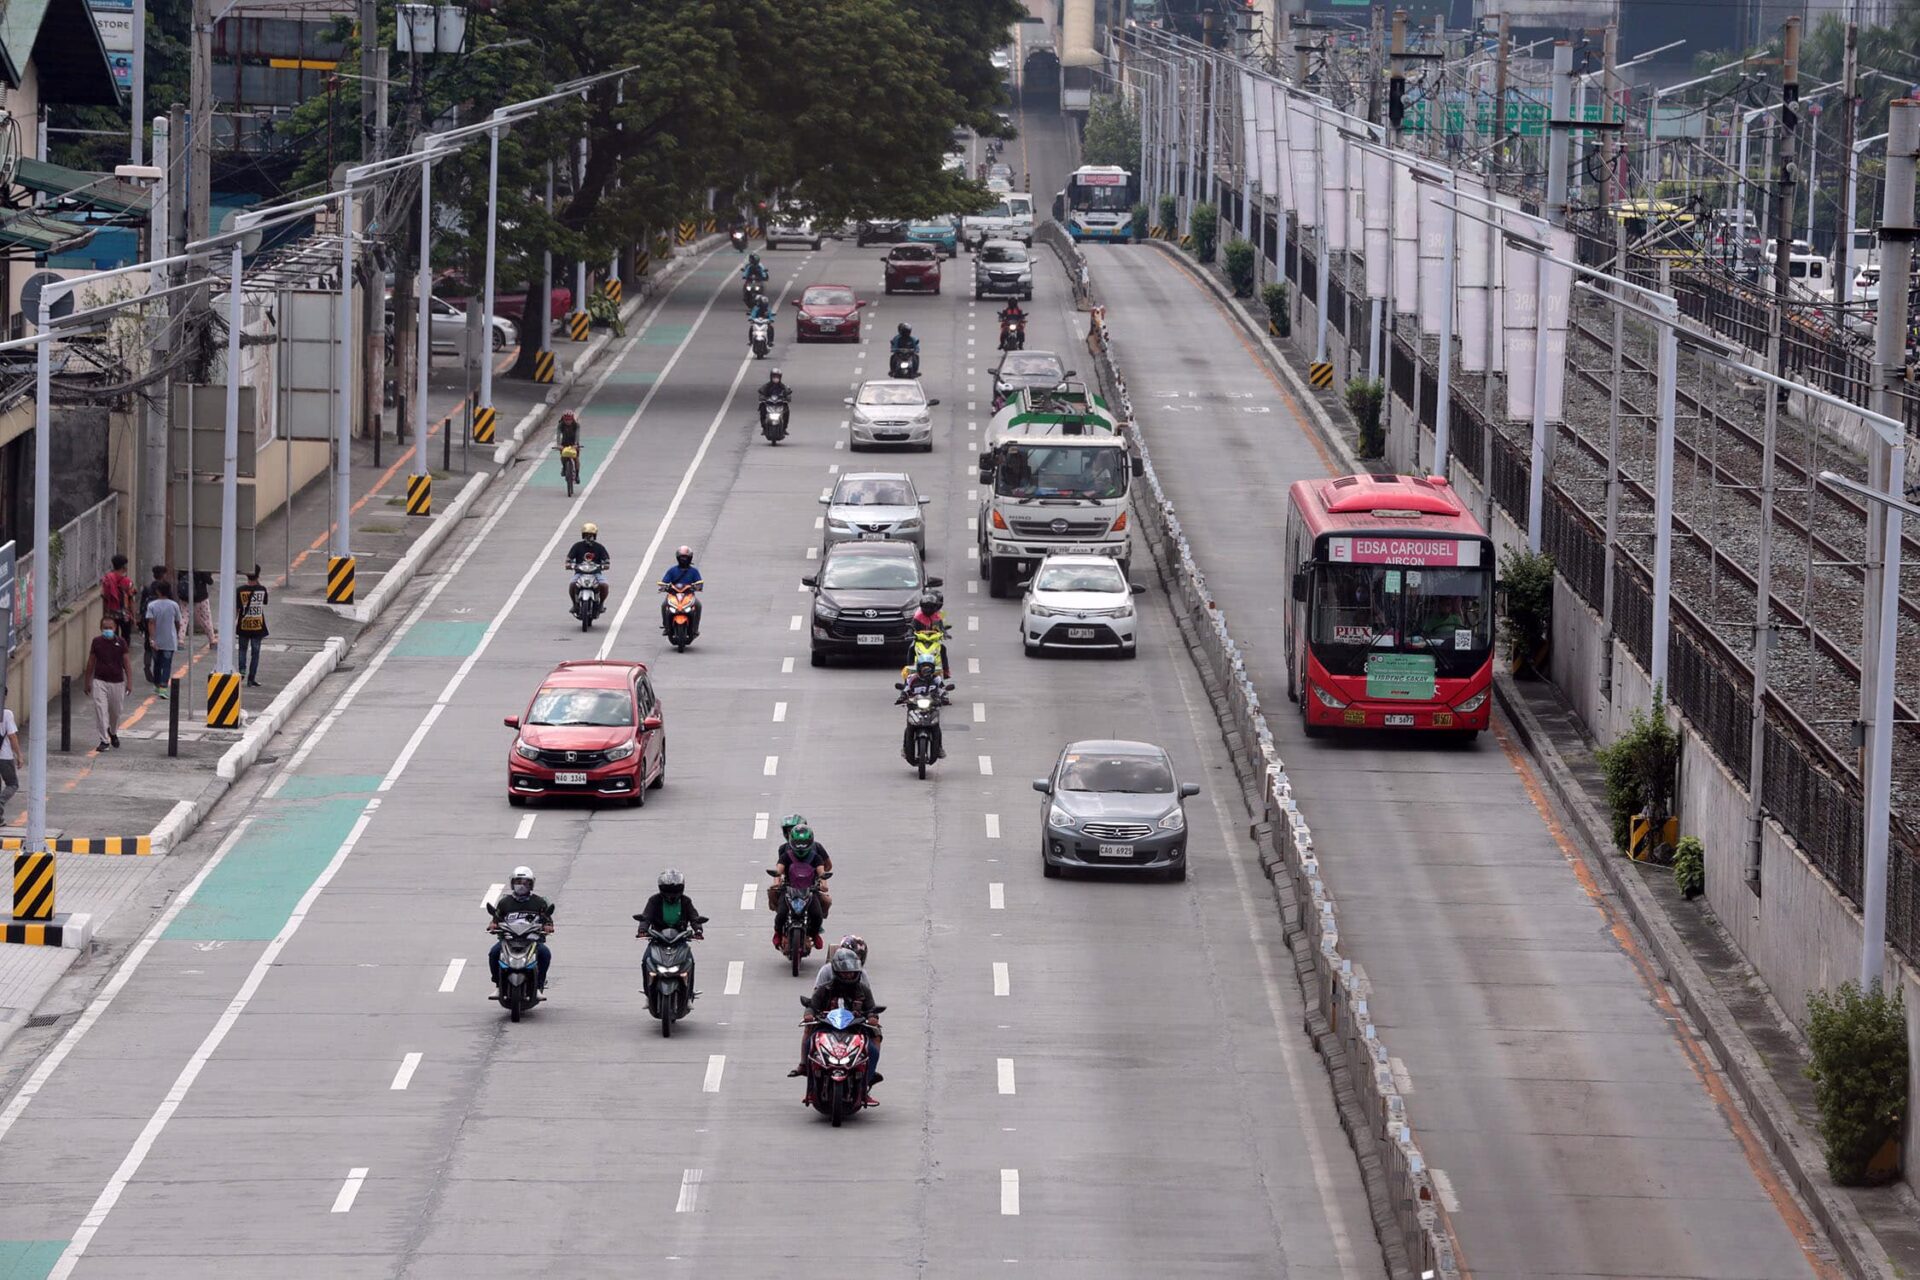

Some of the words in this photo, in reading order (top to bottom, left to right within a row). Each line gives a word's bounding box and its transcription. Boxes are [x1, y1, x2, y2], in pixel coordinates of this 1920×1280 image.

[1334, 545, 1345, 558] E
[1356, 541, 1388, 554] EDSA
[1390, 541, 1454, 556] CAROUSEL
[1385, 556, 1425, 566] AIRCON
[1335, 626, 1371, 638] PITX
